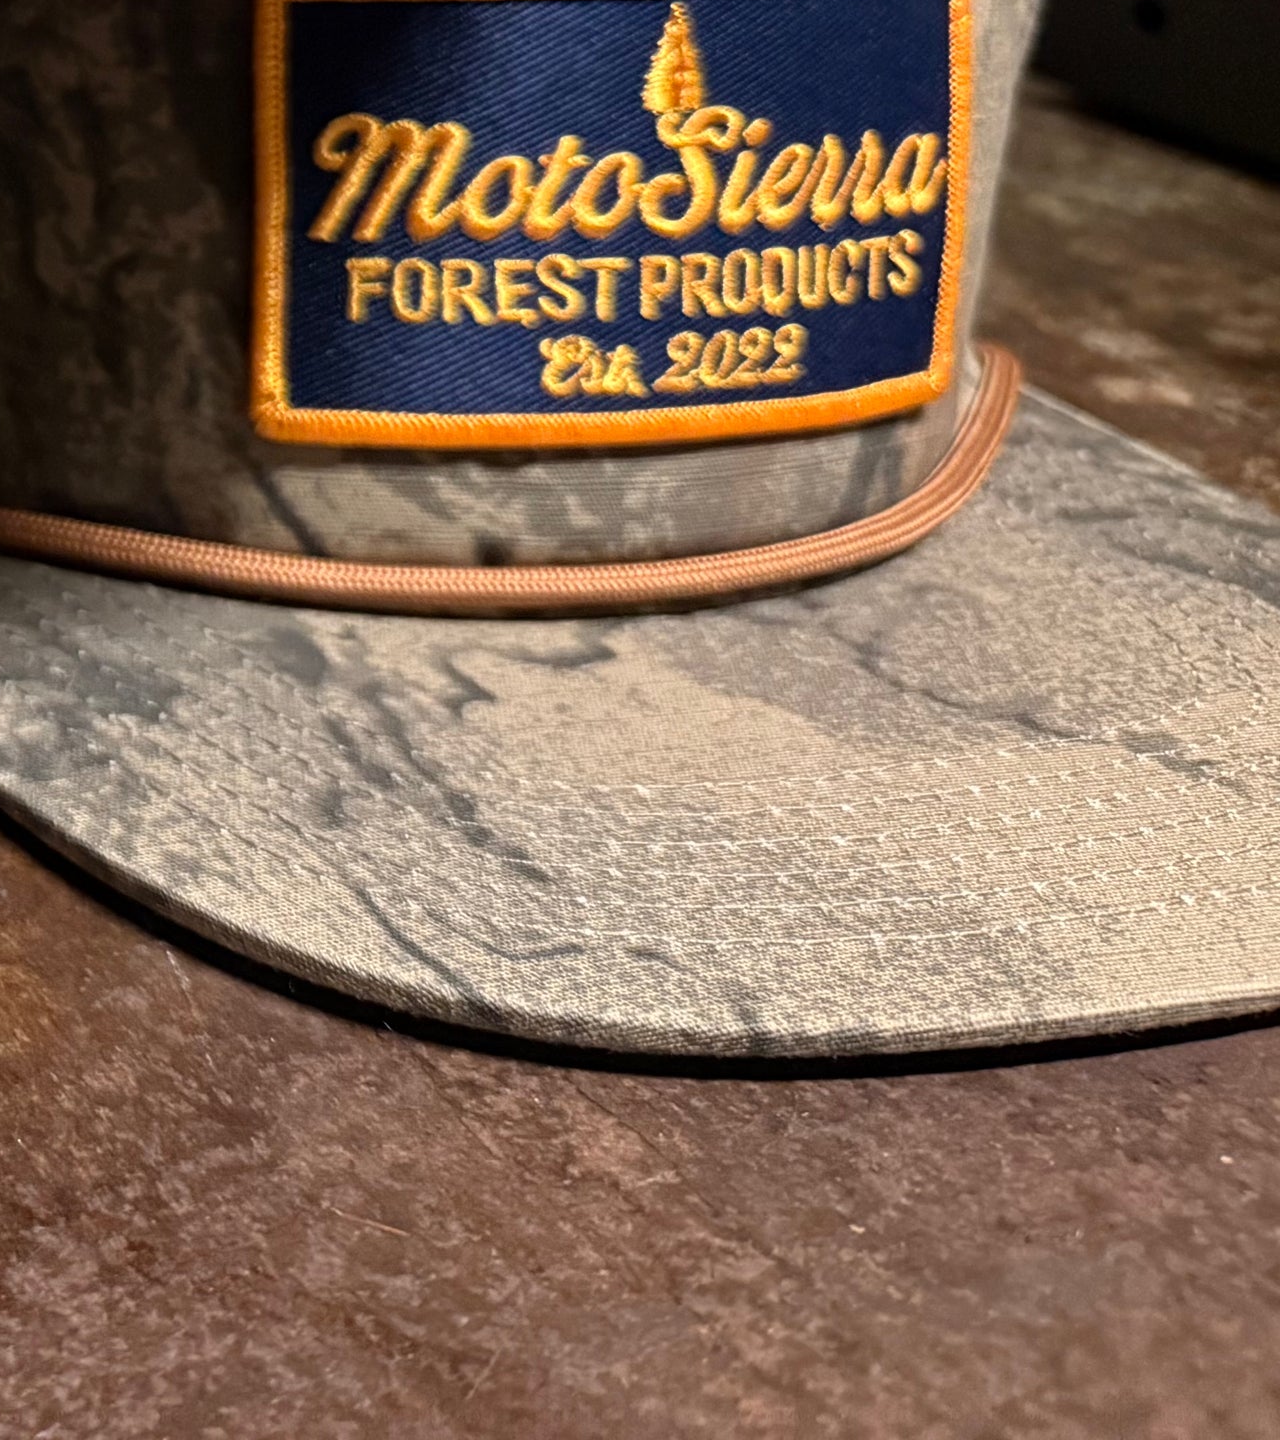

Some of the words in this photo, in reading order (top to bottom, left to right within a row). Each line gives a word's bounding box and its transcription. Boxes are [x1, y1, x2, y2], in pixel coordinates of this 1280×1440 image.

[305, 103, 948, 245] MotoSierra
[344, 252, 633, 328] FOREST
[640, 227, 925, 321] PRODUCTS
[652, 322, 811, 394] 2022
